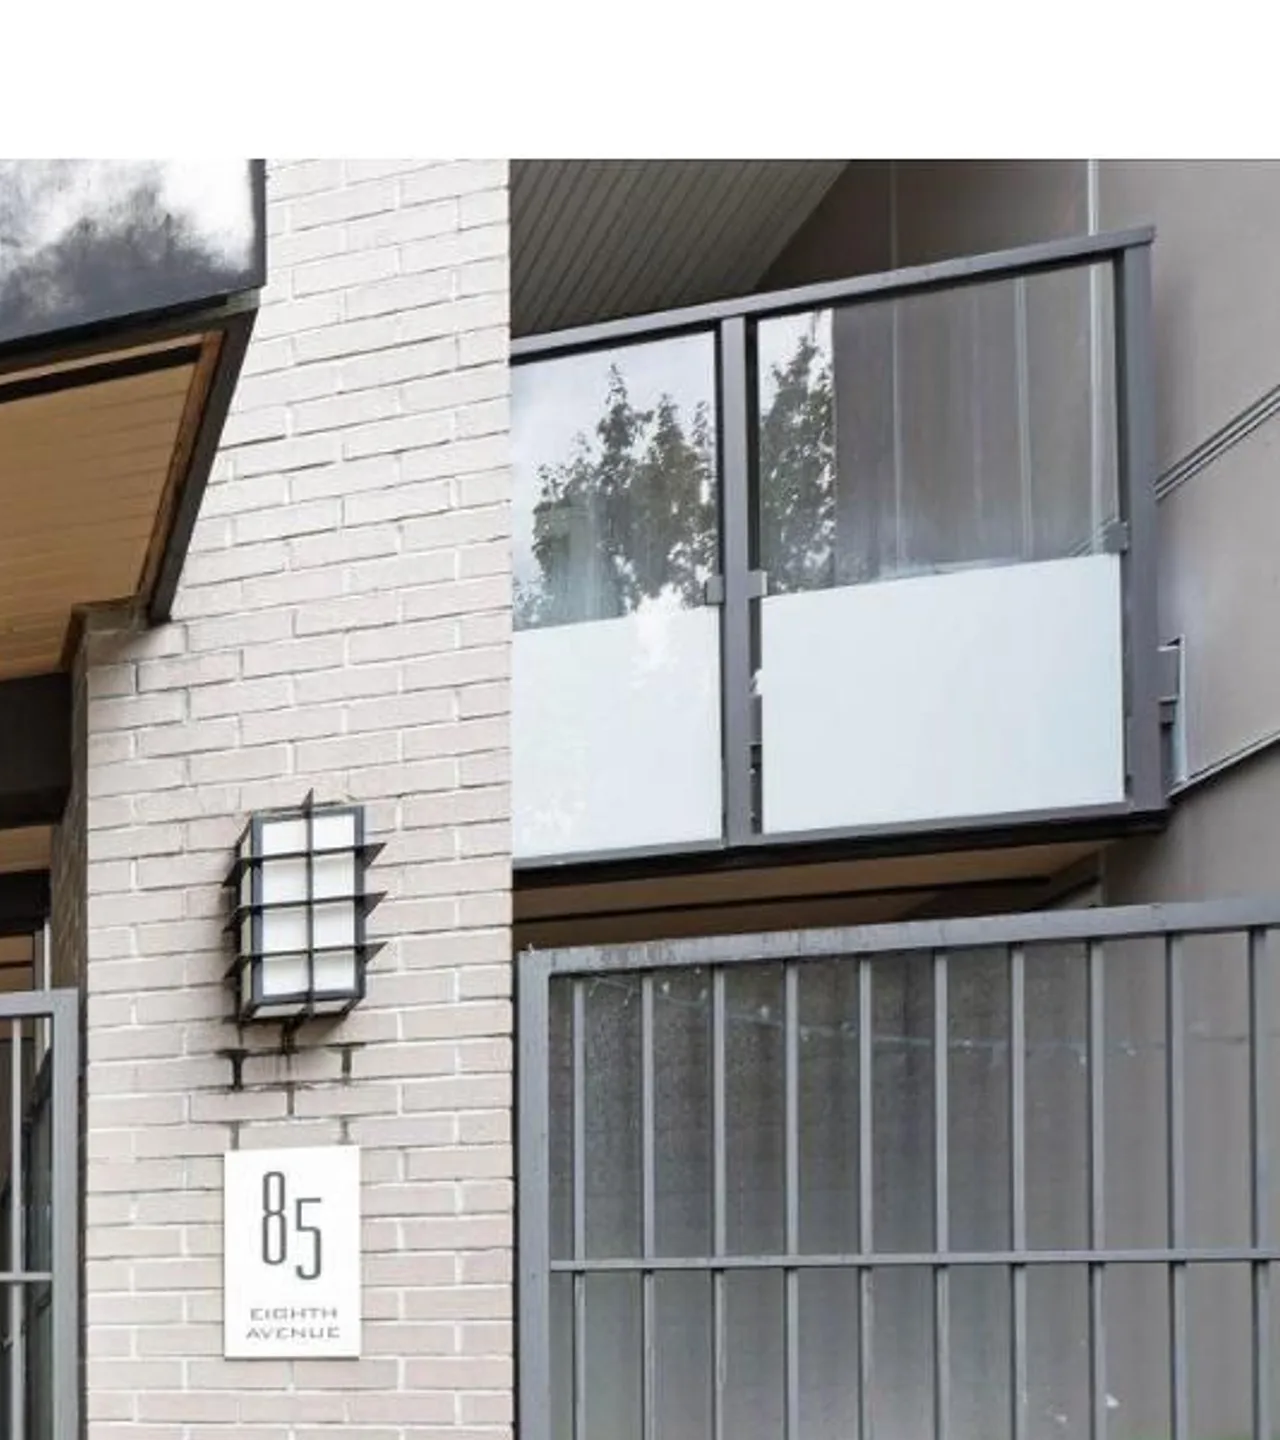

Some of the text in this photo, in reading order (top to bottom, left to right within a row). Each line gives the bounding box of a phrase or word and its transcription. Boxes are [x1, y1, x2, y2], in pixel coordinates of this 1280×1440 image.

[261, 1171, 322, 1280] 85
[249, 1306, 338, 1322] EIGHTH
[245, 1325, 341, 1340] AVENUE
